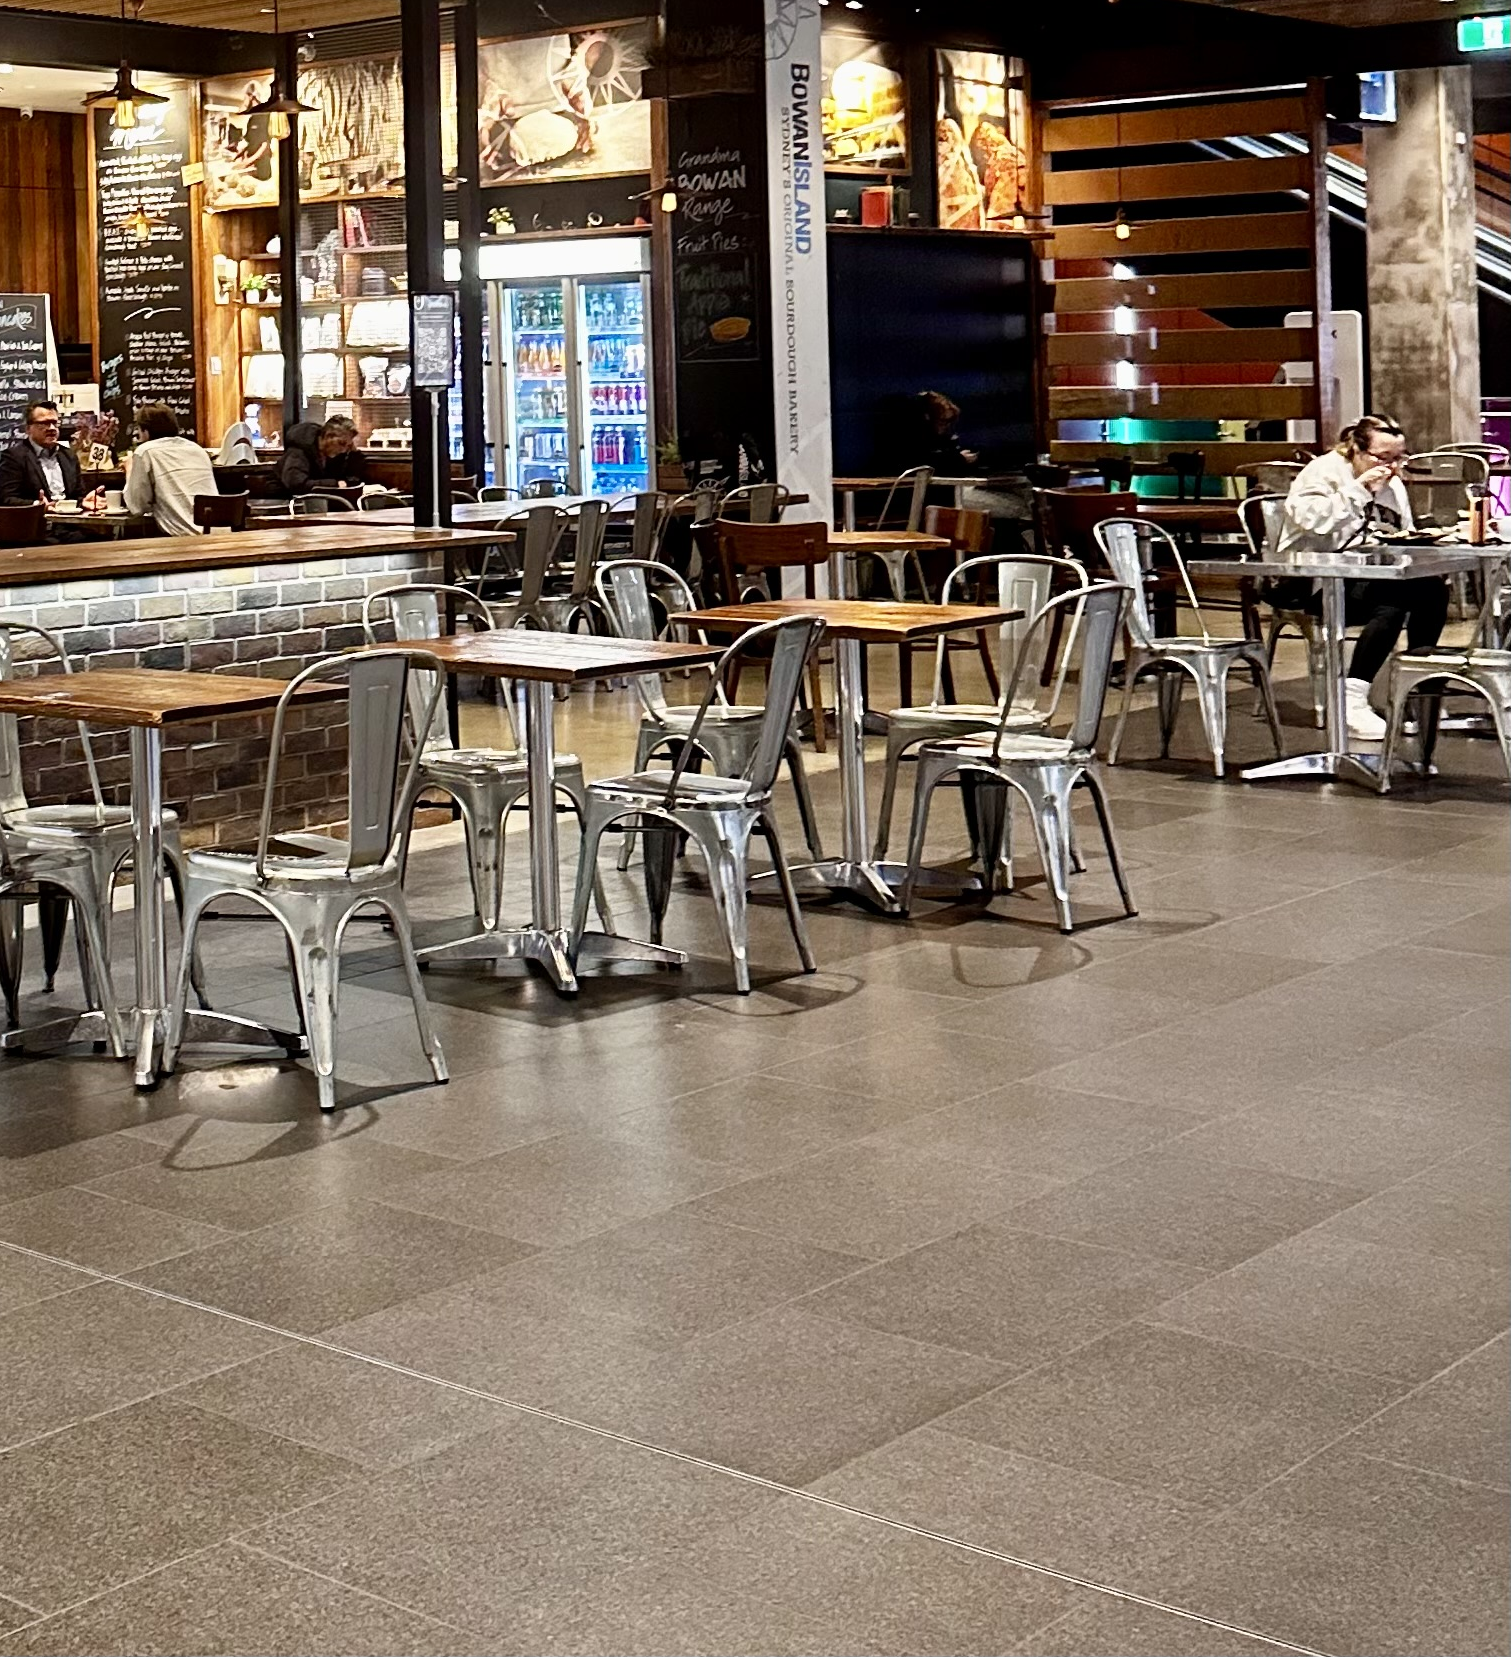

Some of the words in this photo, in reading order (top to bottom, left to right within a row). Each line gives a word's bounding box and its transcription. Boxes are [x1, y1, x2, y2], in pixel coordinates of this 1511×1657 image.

[677, 146, 741, 169] Grandma
[676, 165, 747, 193] BOWAN
[681, 196, 734, 225] Range
[676, 232, 709, 255] Fruit
